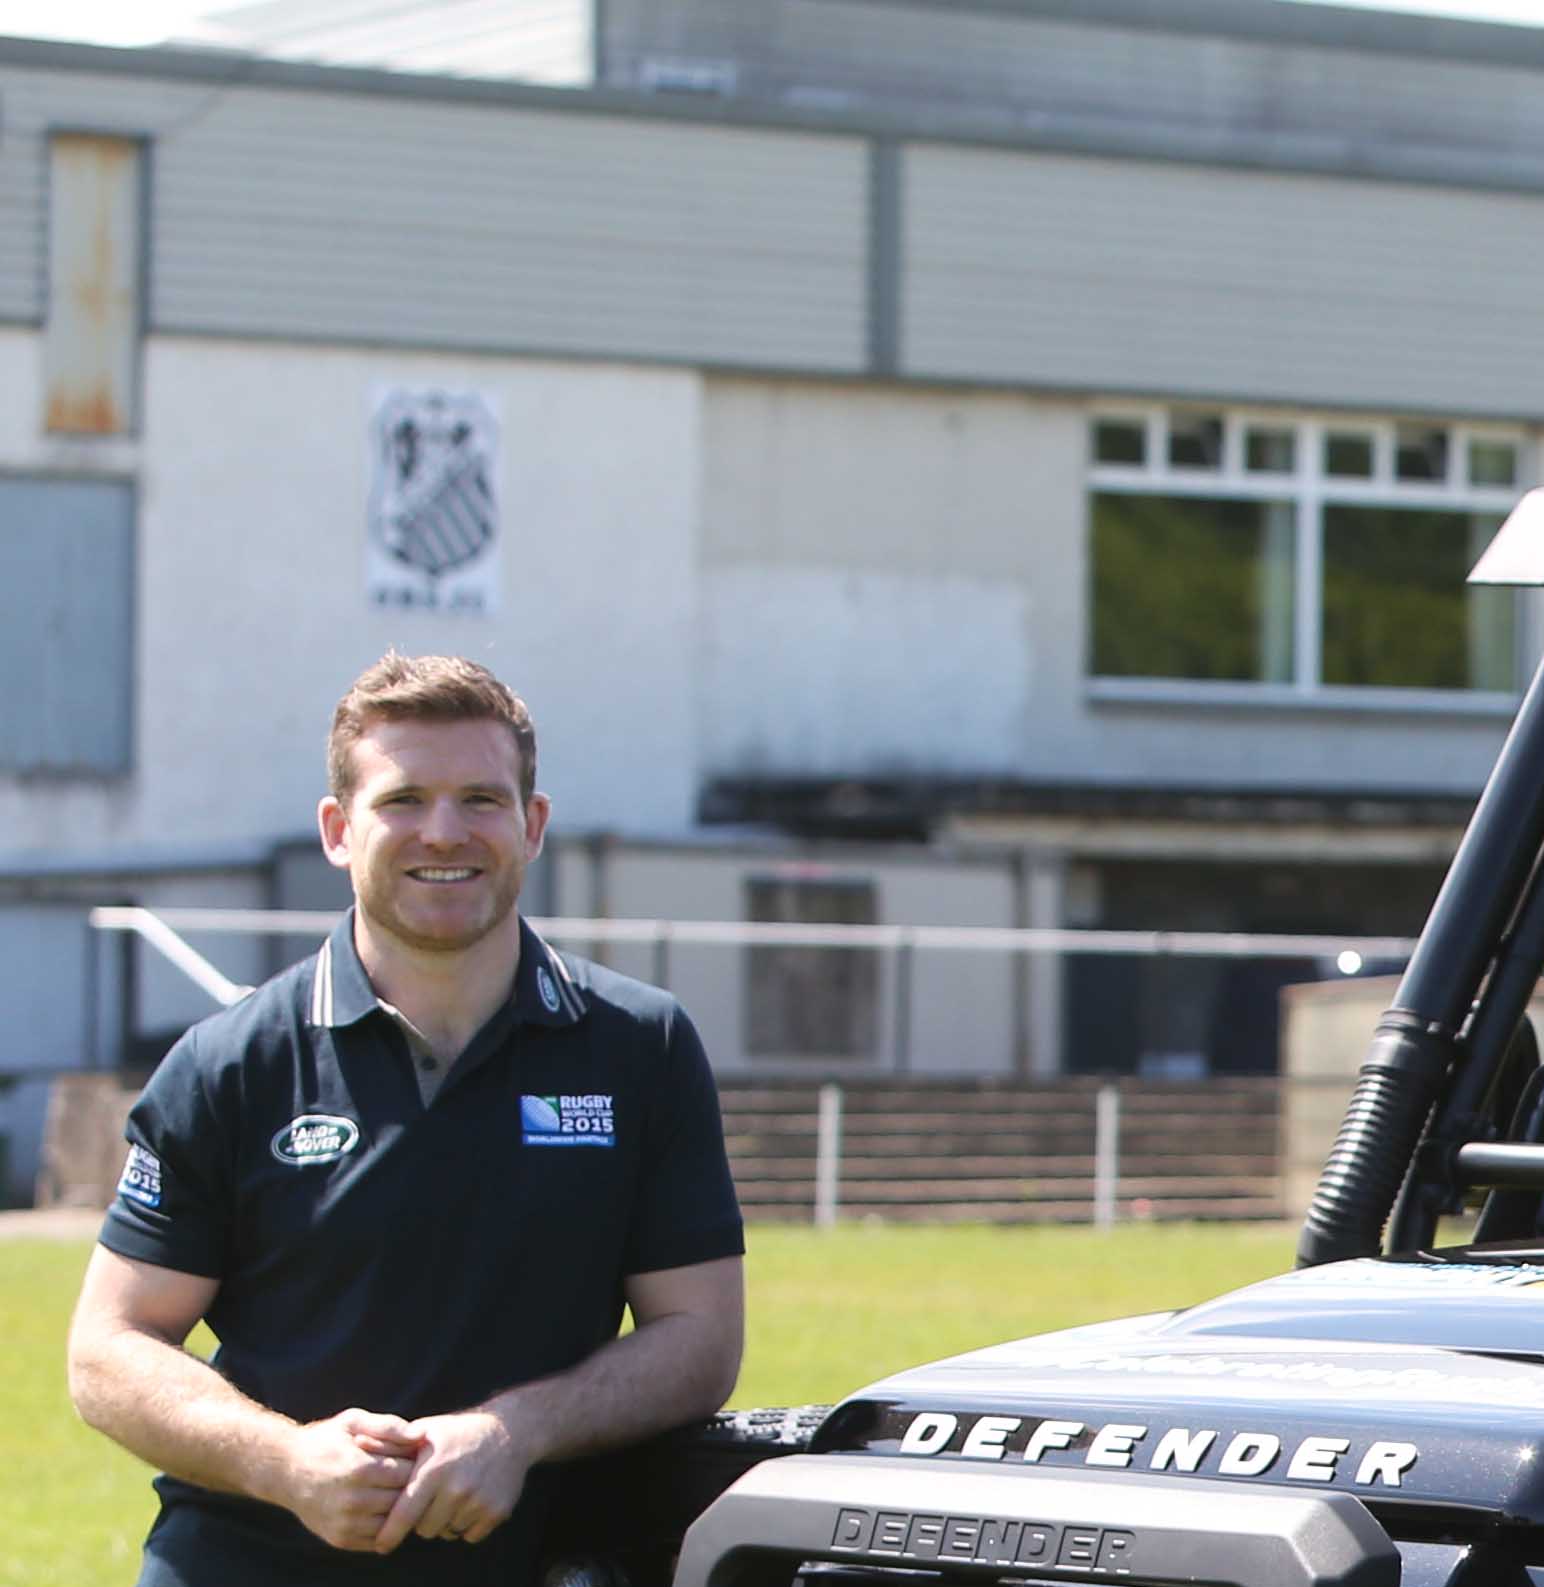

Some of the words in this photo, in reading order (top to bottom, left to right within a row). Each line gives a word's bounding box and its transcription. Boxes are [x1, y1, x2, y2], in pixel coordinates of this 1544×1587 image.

[560, 1095, 613, 1109] RUGBY
[561, 1117, 615, 1133] 2015
[900, 1411, 1419, 1487] DEFENDER
[830, 1507, 1137, 1575] DEFENDER
